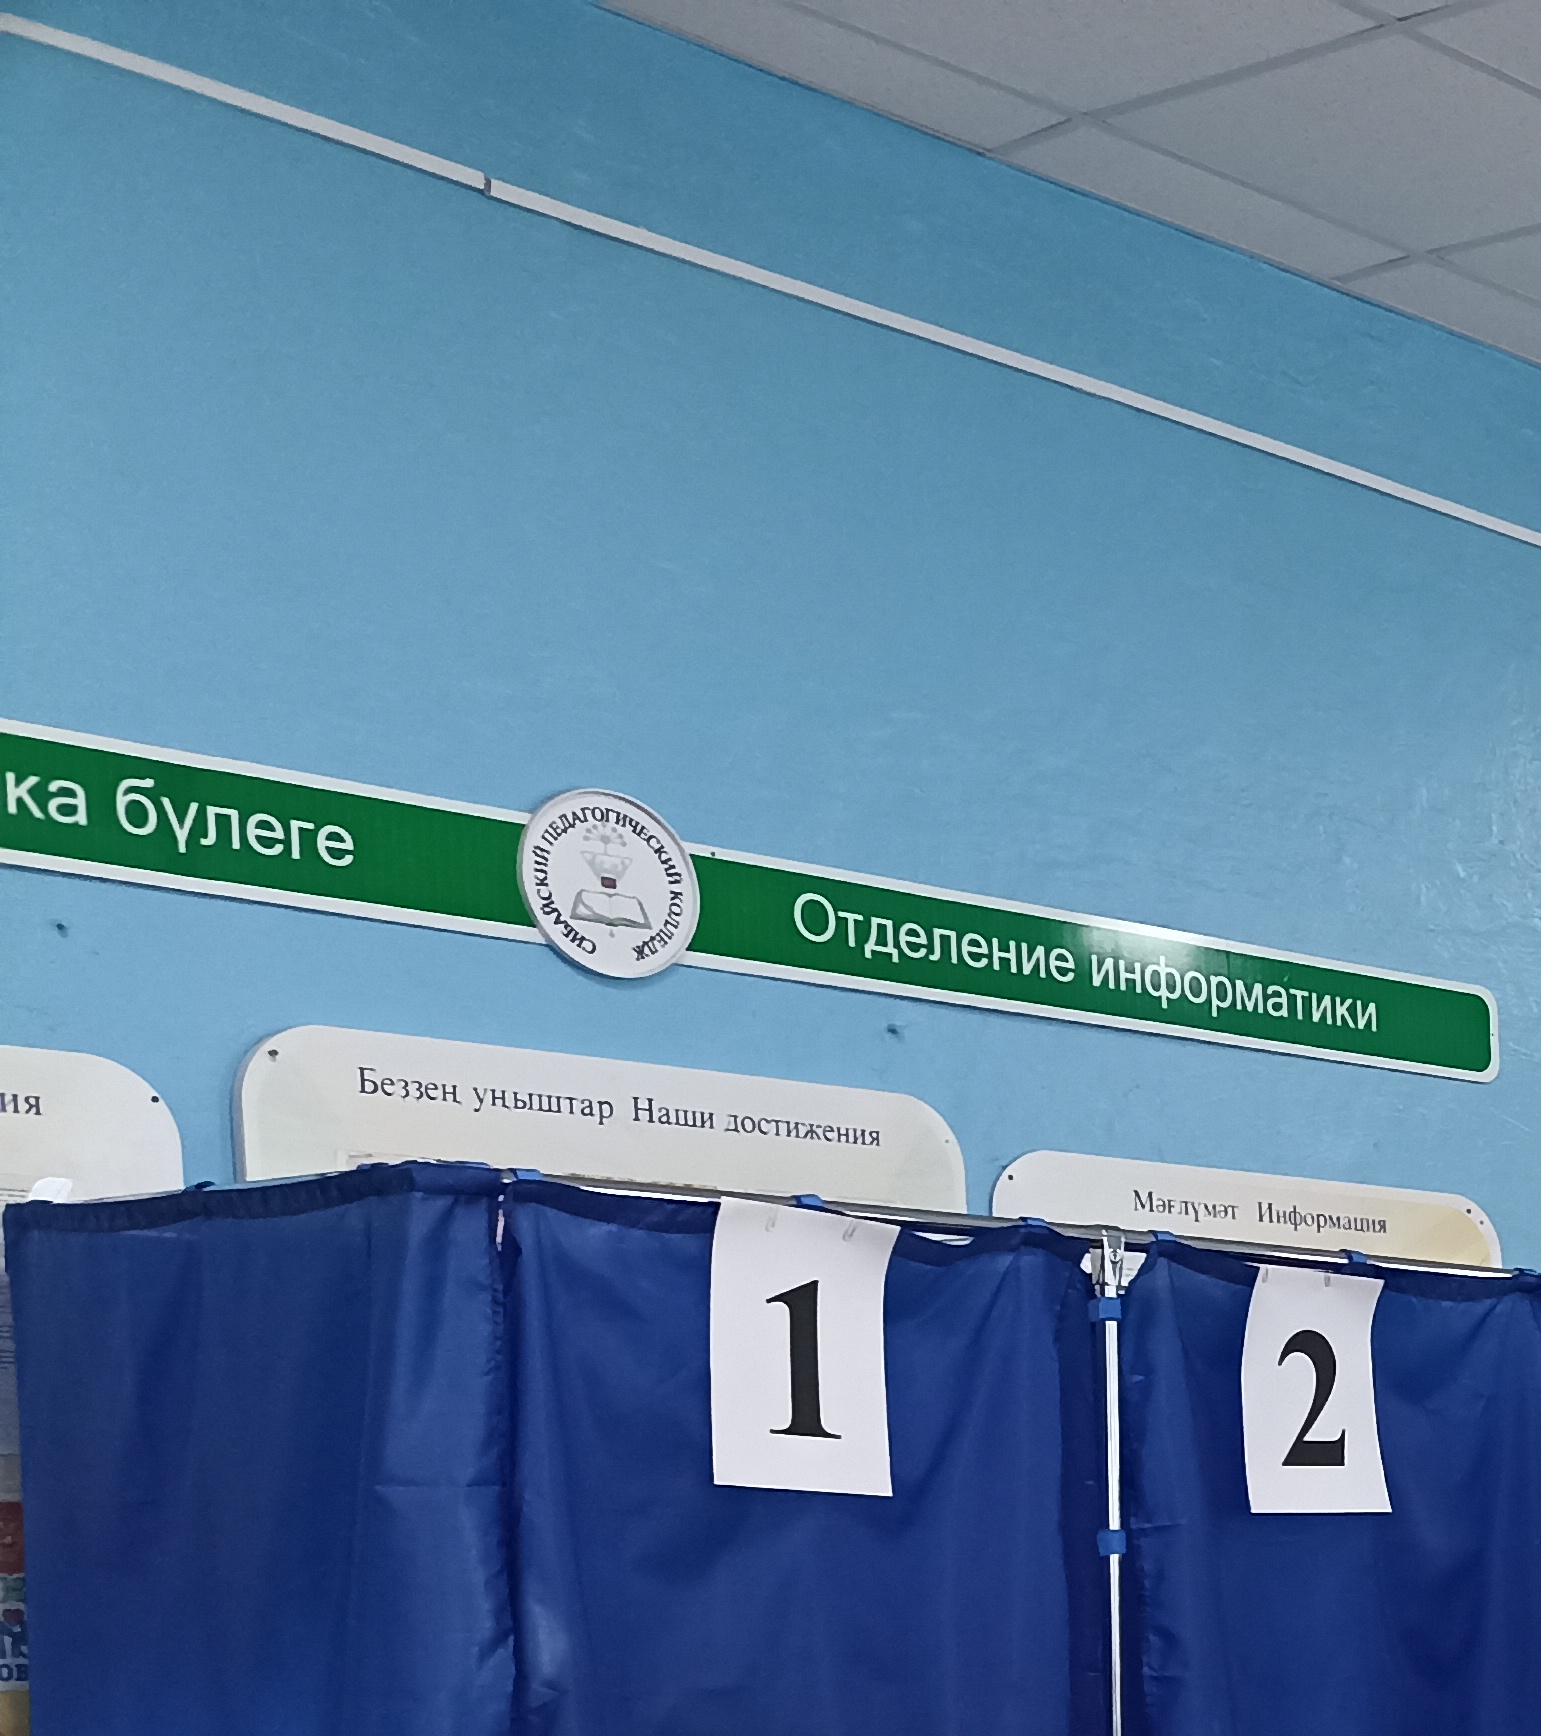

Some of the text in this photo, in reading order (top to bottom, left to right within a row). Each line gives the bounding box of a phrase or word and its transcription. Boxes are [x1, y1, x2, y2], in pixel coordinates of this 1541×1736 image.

[5, 771, 354, 867] ка бүлеге
[532, 806, 684, 961] СИБАЙСКИЙ ПЕДАГОГИЧЕСКИЙ КОЛЛЕДЖ
[793, 892, 1378, 1032] Отделение информатики
[632, 1096, 715, 1130] Наши
[724, 1113, 881, 1147] достижения
[1257, 1201, 1388, 1234] Информация
[765, 1279, 842, 1440] 1
[1277, 1329, 1347, 1467] 2
